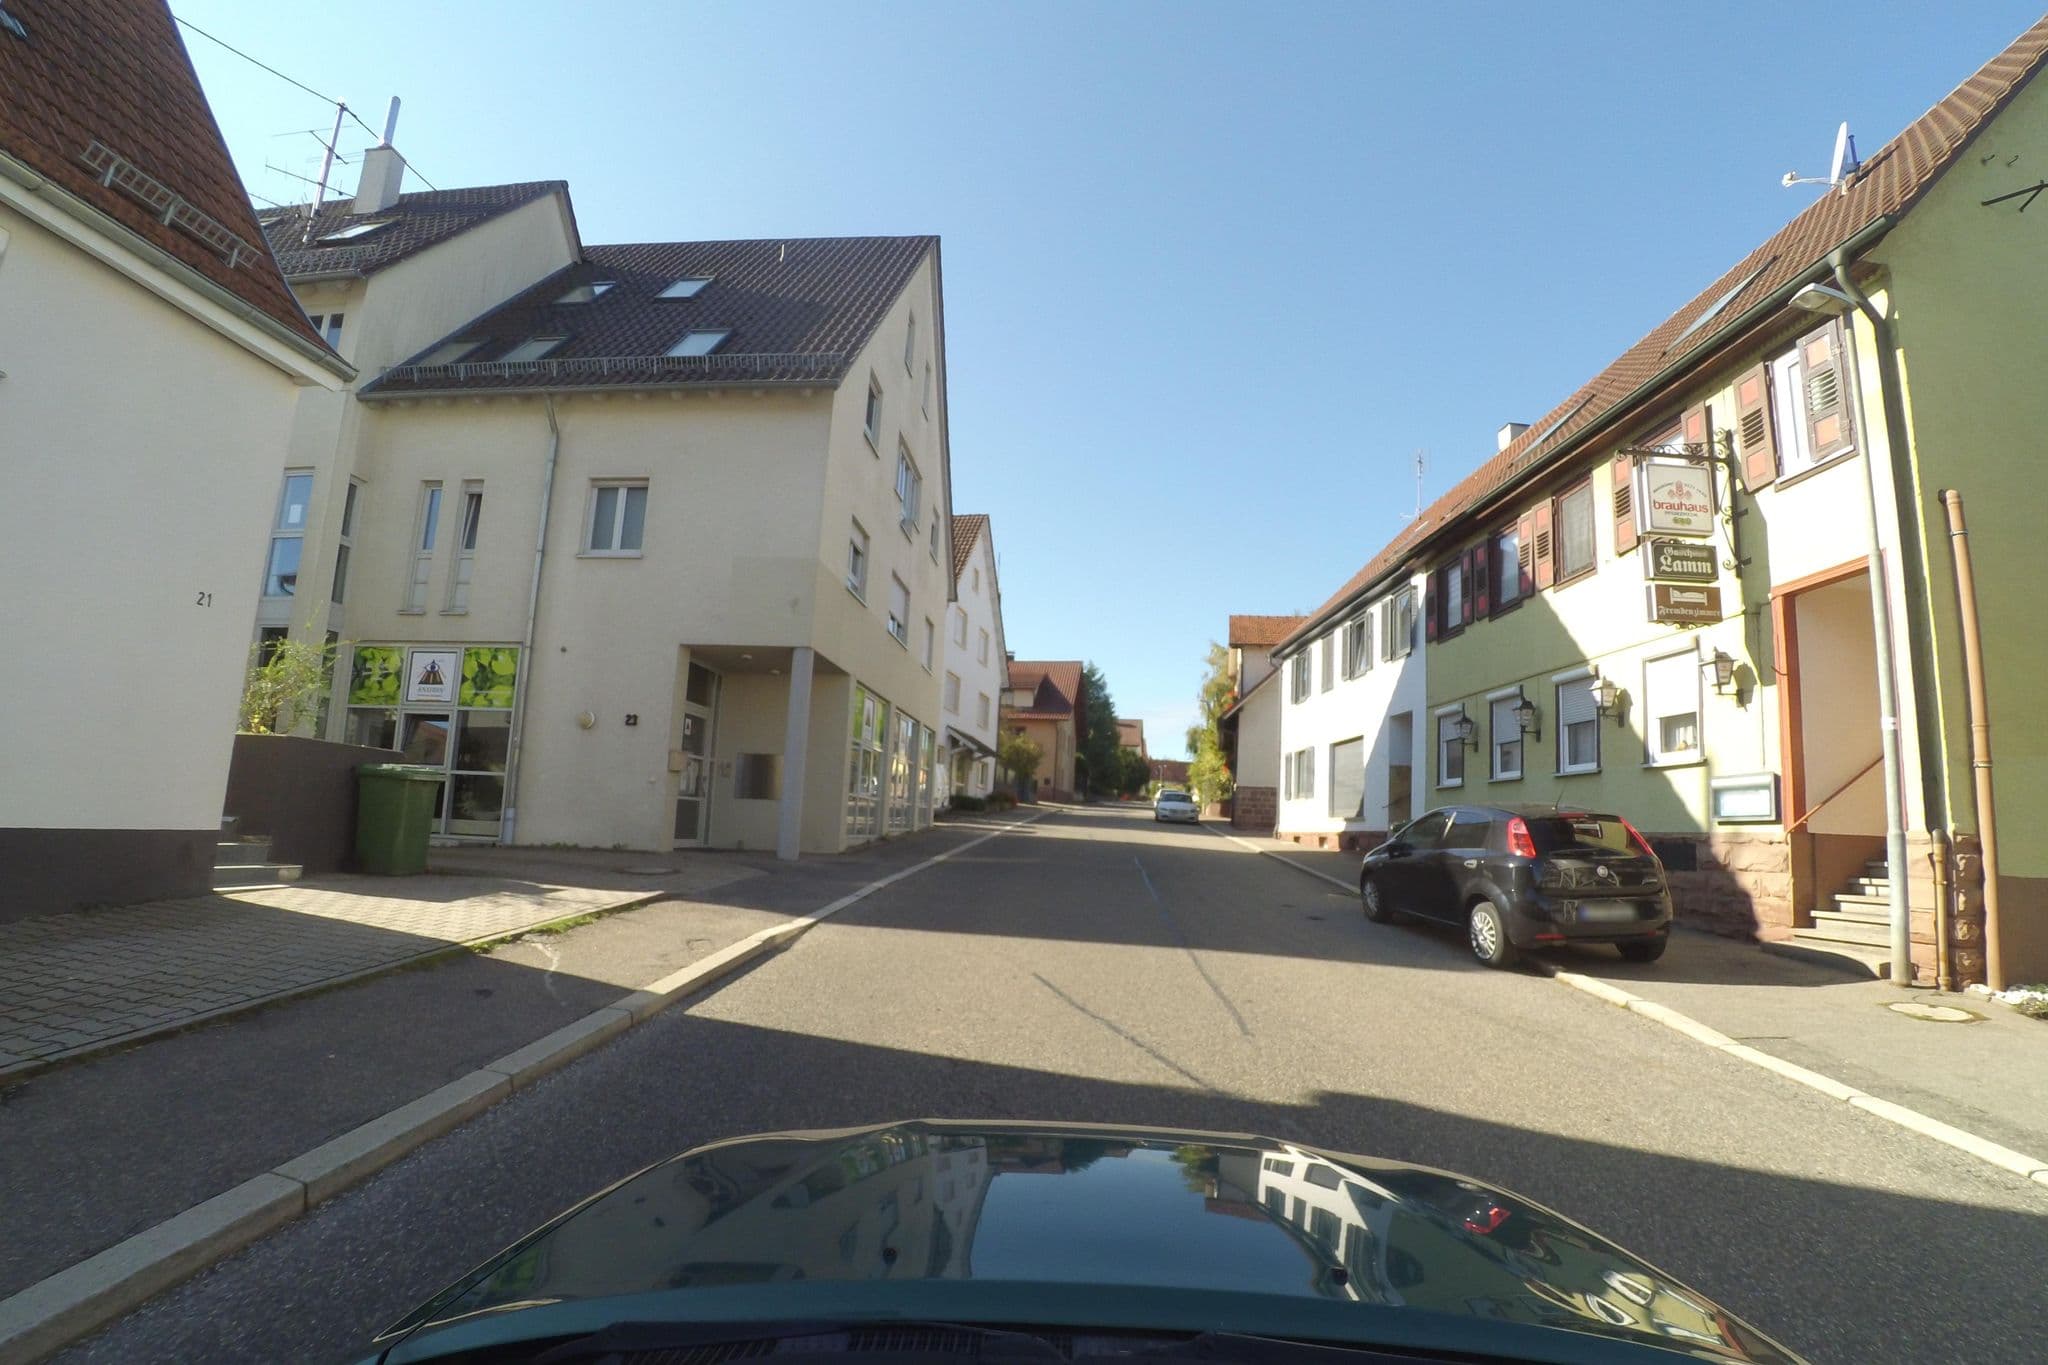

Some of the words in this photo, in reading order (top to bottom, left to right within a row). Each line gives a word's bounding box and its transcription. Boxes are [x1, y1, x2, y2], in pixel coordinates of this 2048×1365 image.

[1653, 499, 1709, 513] brauhaus
[1664, 546, 1708, 558] Gasth
[1659, 554, 1712, 574] Lamm
[196, 591, 212, 607] 21
